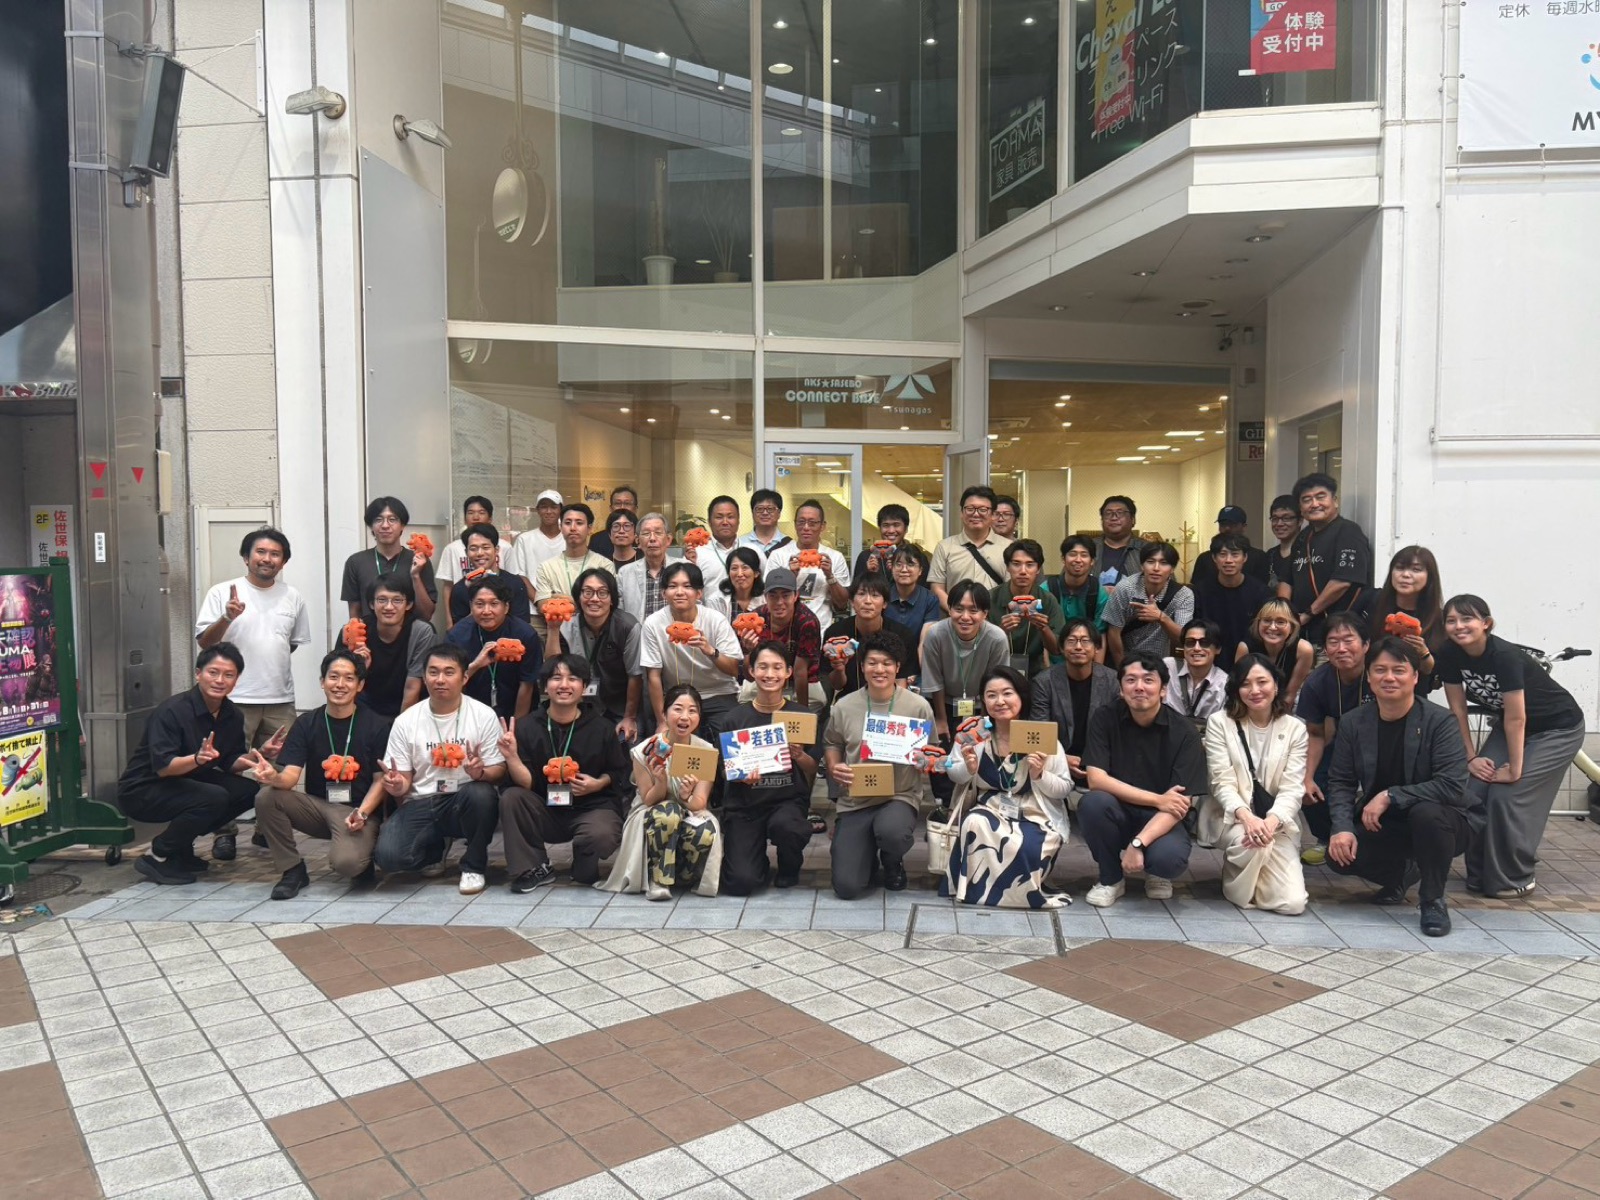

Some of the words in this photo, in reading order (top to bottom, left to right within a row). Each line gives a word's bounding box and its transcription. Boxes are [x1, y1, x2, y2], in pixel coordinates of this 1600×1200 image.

[1498, 3, 1530, 18] 定休
[1284, 11, 1325, 31] 体験
[1262, 32, 1324, 55] 受付中
[785, 391, 848, 403] CONNECT
[36, 514, 49, 524] 2F
[751, 726, 786, 747] 若者賞
[866, 718, 908, 738] 最優秀賞
[752, 776, 793, 787] EANUTS
